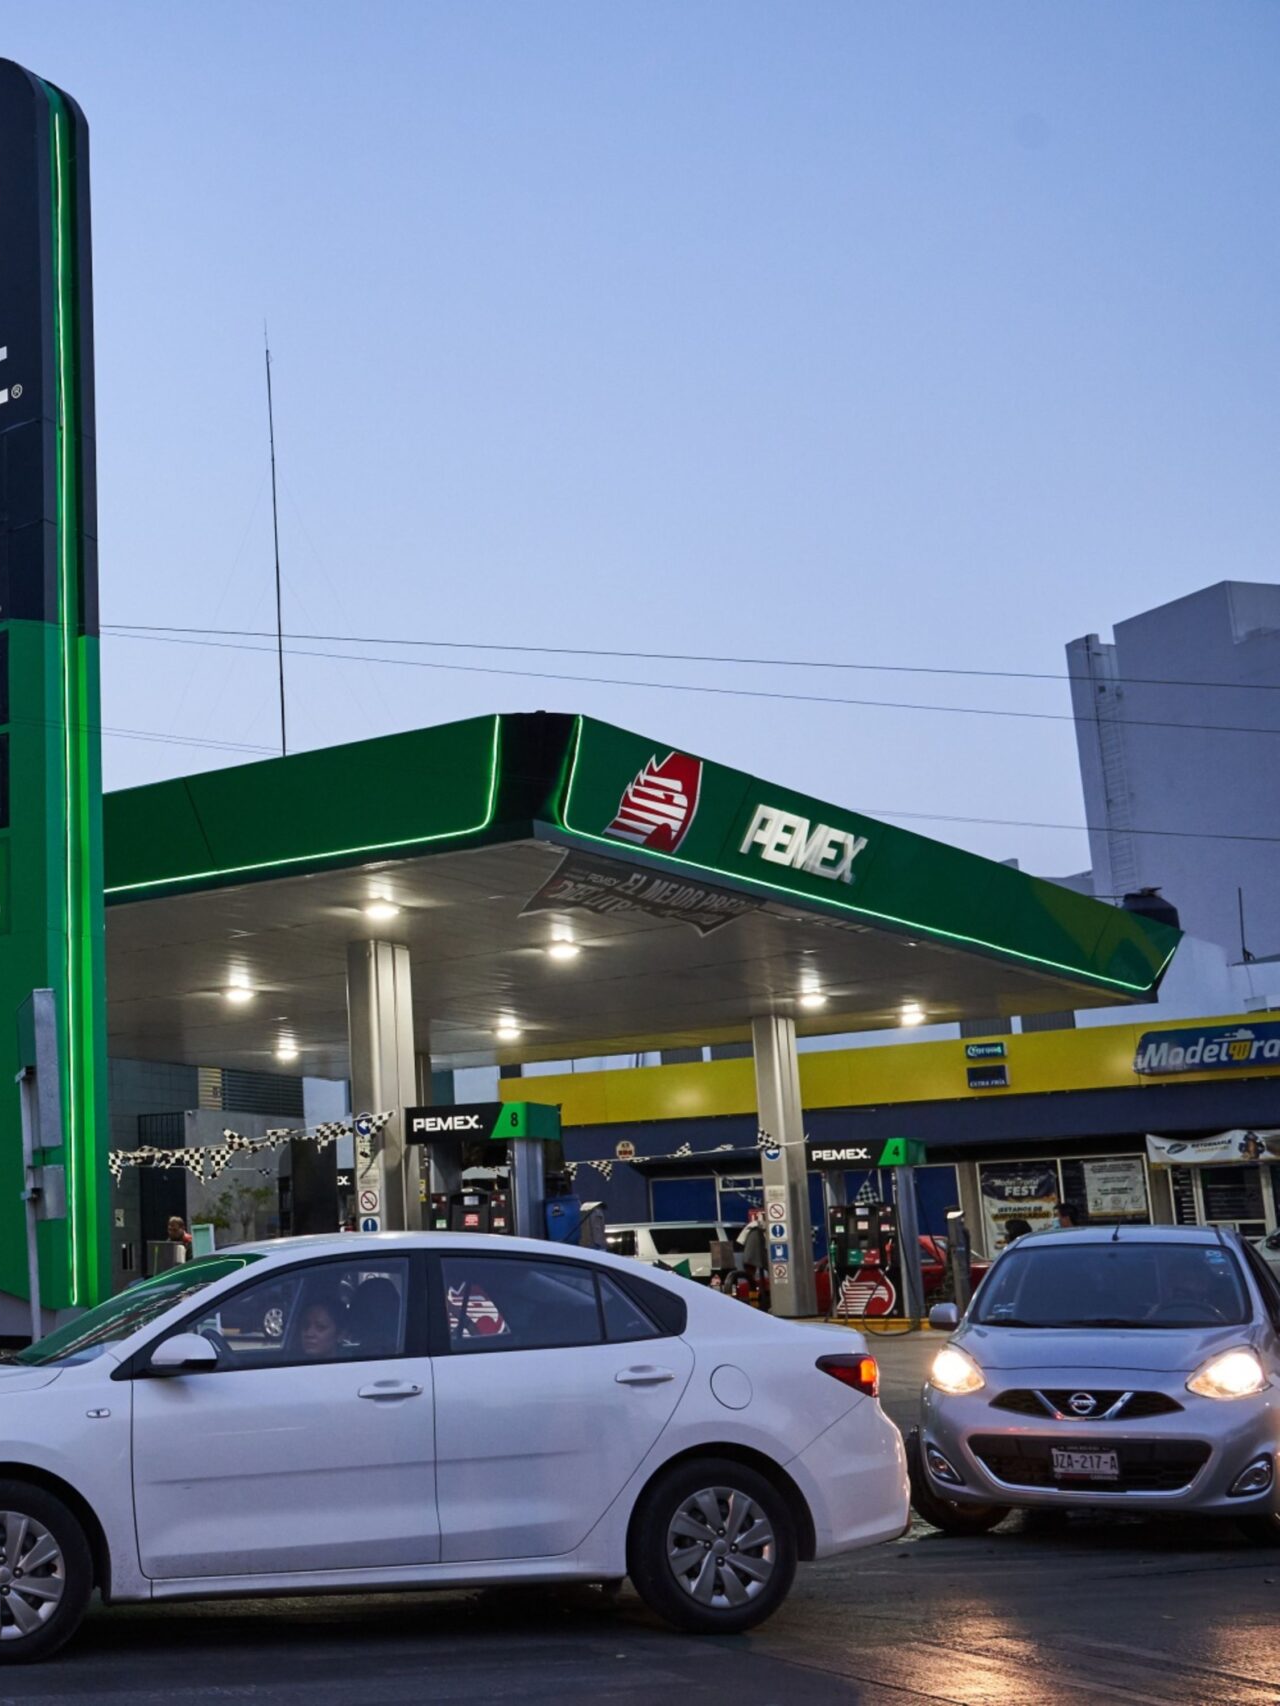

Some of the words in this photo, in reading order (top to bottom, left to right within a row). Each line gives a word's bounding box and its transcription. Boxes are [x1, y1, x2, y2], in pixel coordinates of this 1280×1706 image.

[739, 804, 868, 885] PEMEX
[413, 1115, 480, 1132] PEMEX
[510, 1112, 519, 1127] 8
[811, 1148, 868, 1161] PEMEX
[892, 1145, 900, 1157] 4
[1004, 1185, 1038, 1197] FEST
